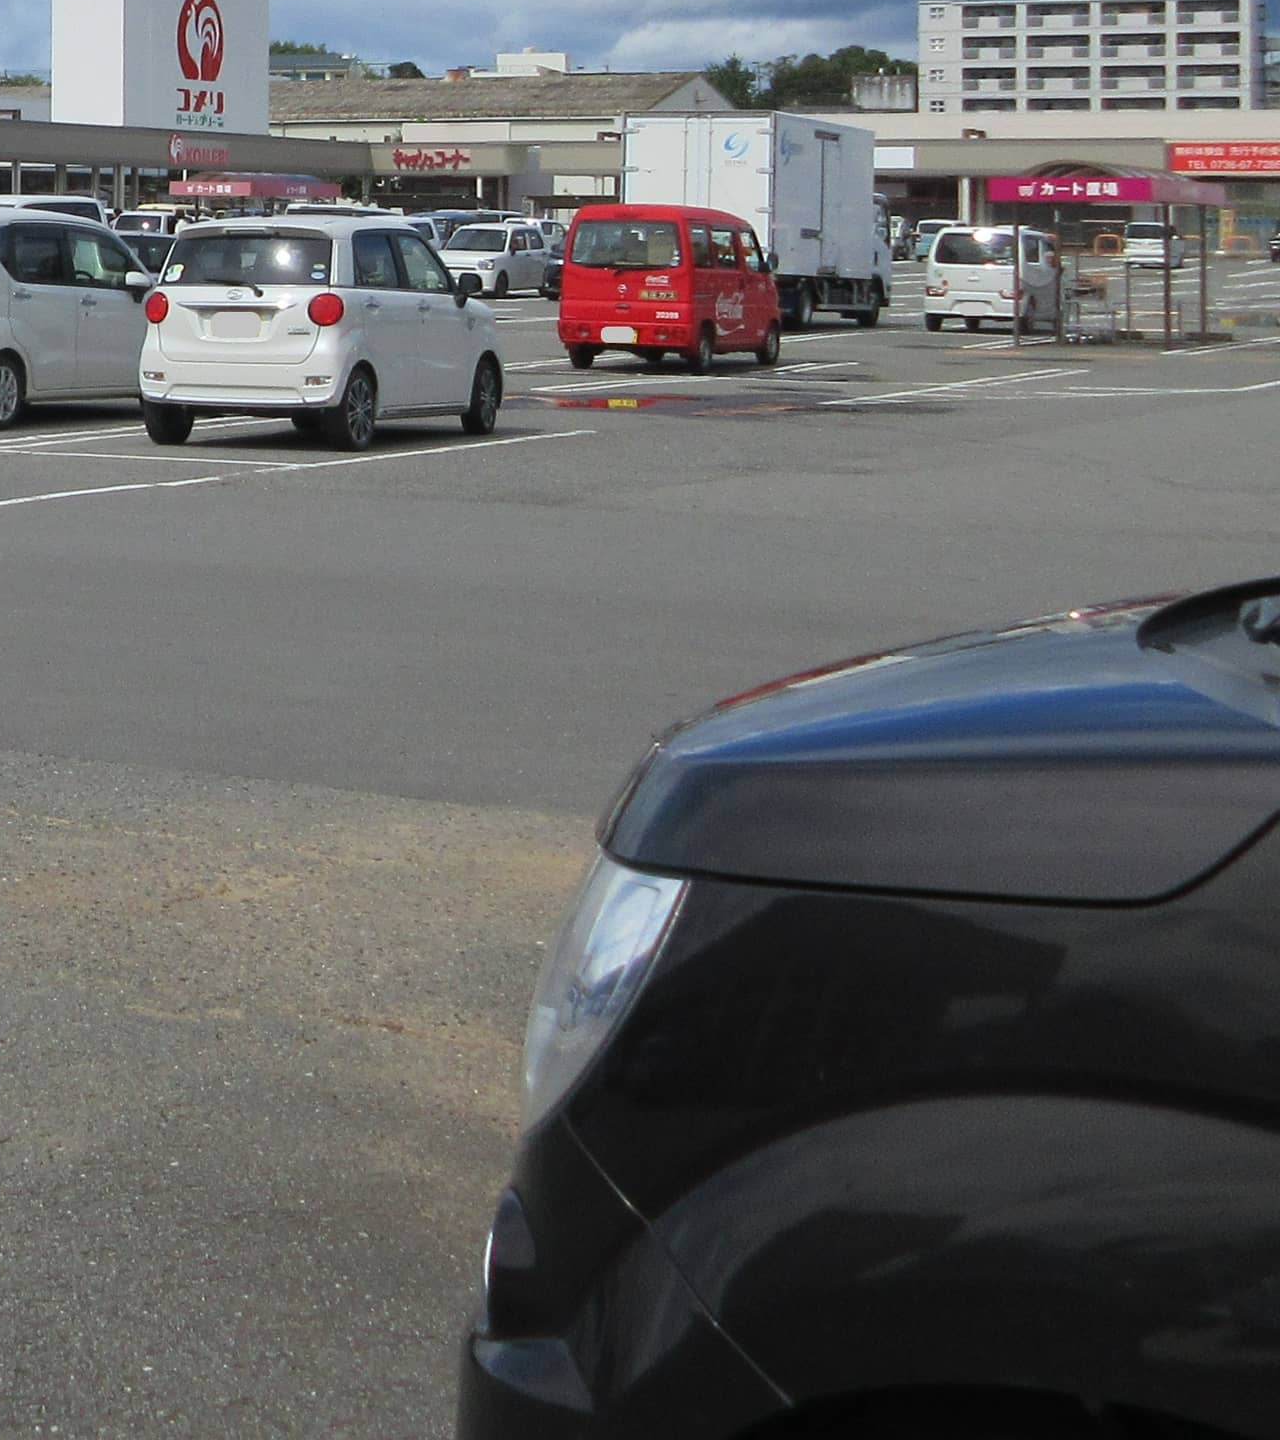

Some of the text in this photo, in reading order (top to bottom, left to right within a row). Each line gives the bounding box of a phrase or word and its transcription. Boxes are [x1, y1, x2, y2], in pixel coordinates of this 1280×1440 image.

[176, 88, 224, 114] コメリ
[1187, 160, 1208, 169] TEL
[1040, 181, 1119, 197] カート置場
